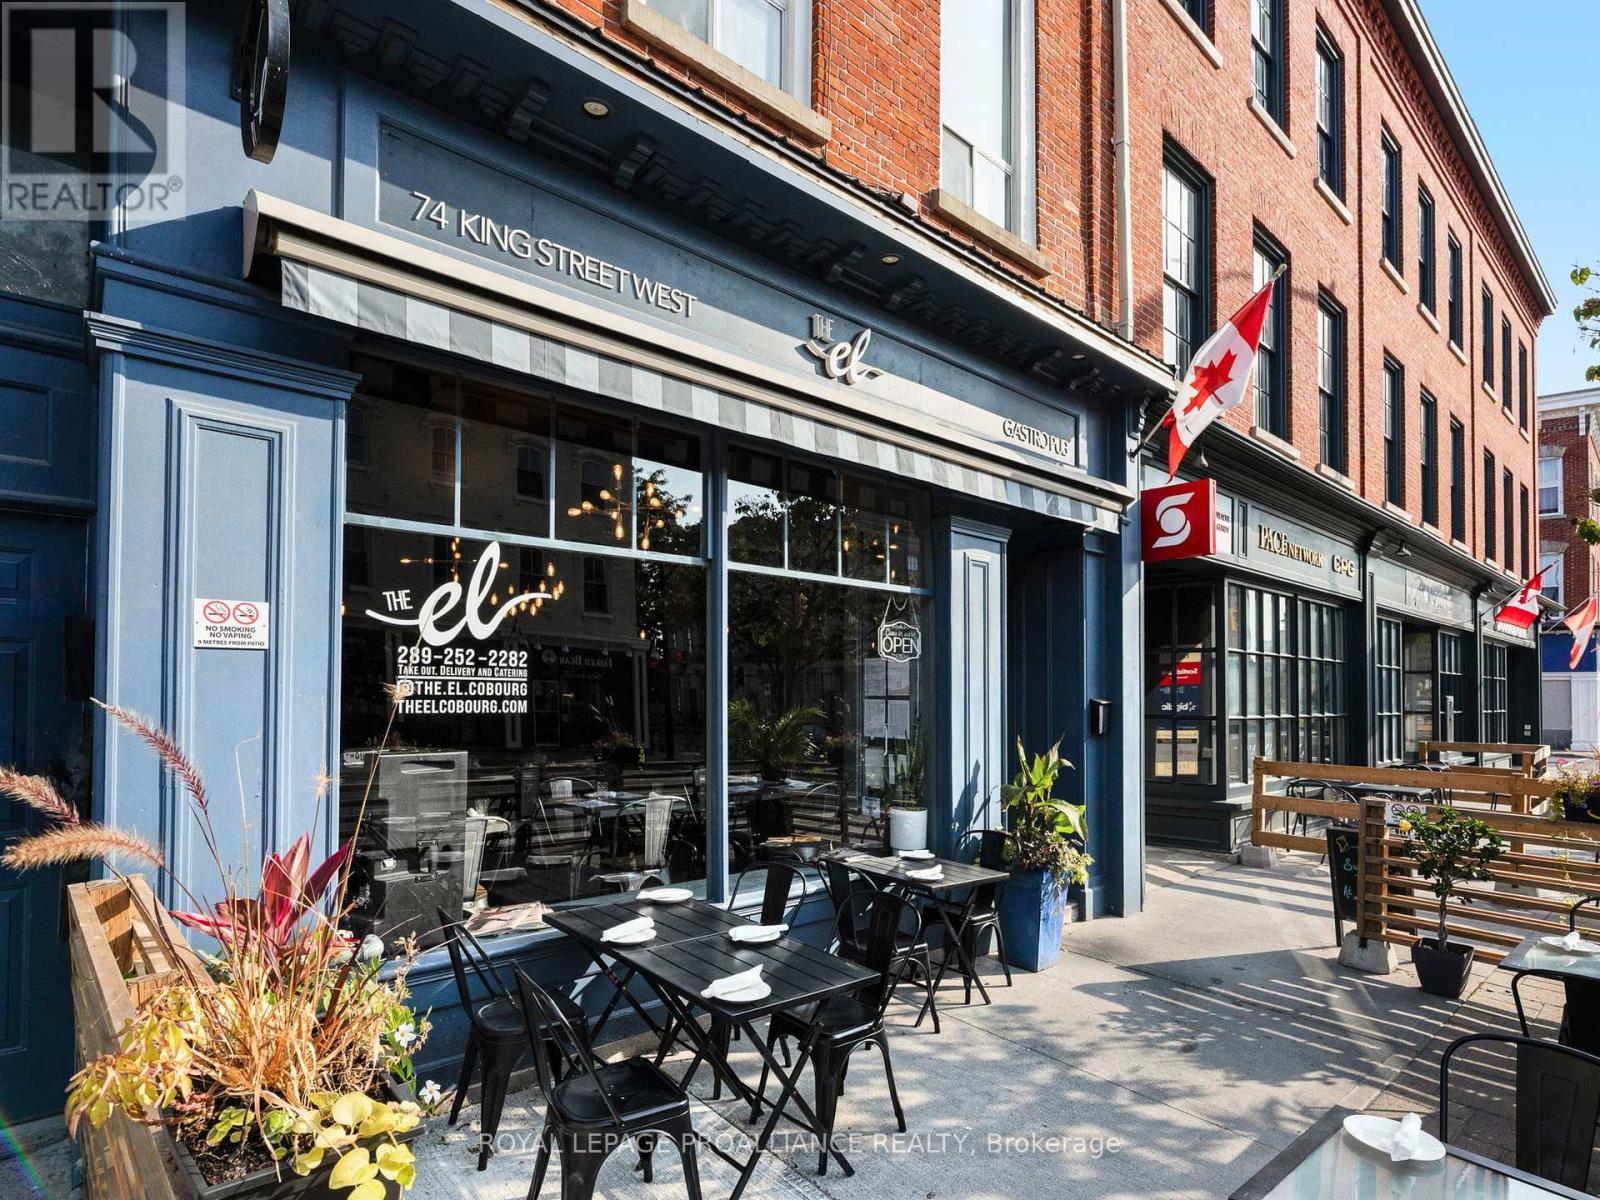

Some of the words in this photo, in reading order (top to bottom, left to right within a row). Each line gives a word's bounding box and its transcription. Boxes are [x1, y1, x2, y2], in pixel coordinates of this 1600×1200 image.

[410, 190, 449, 230] 74
[458, 209, 532, 259] KING
[534, 238, 631, 293] STREET
[632, 272, 698, 318] WEST
[810, 313, 835, 343] THE
[804, 327, 885, 386] el
[365, 541, 553, 647] el
[382, 589, 414, 612] THE
[397, 645, 528, 668] 289-252-2282
[882, 636, 919, 653] OPEN
[398, 699, 528, 714] THEELCOBOURG.COM
